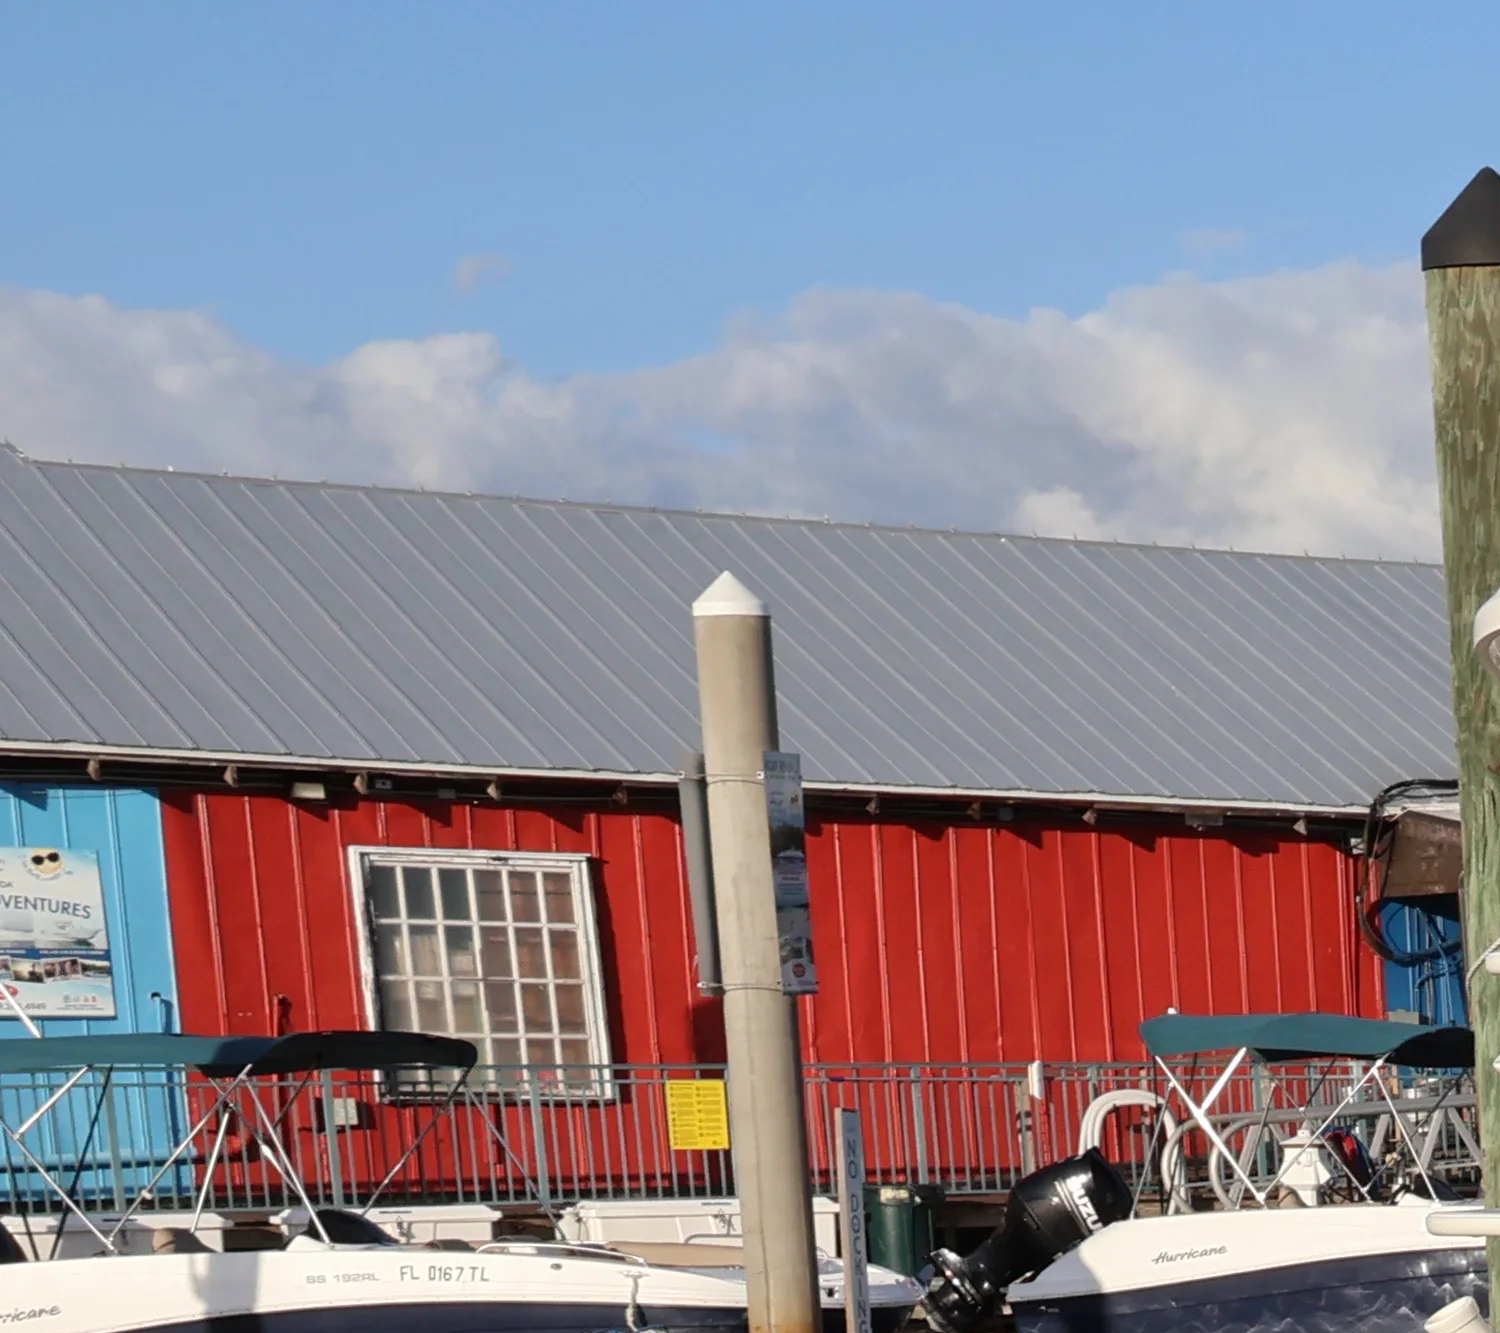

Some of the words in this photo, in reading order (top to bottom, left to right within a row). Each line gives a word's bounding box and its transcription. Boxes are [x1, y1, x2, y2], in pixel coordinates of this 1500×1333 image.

[0, 894, 92, 919] VENTURES
[1150, 1245, 1228, 1265] Hurricane
[399, 1265, 420, 1281] FL
[428, 1266, 465, 1282] 0167
[469, 1266, 490, 1282] TL
